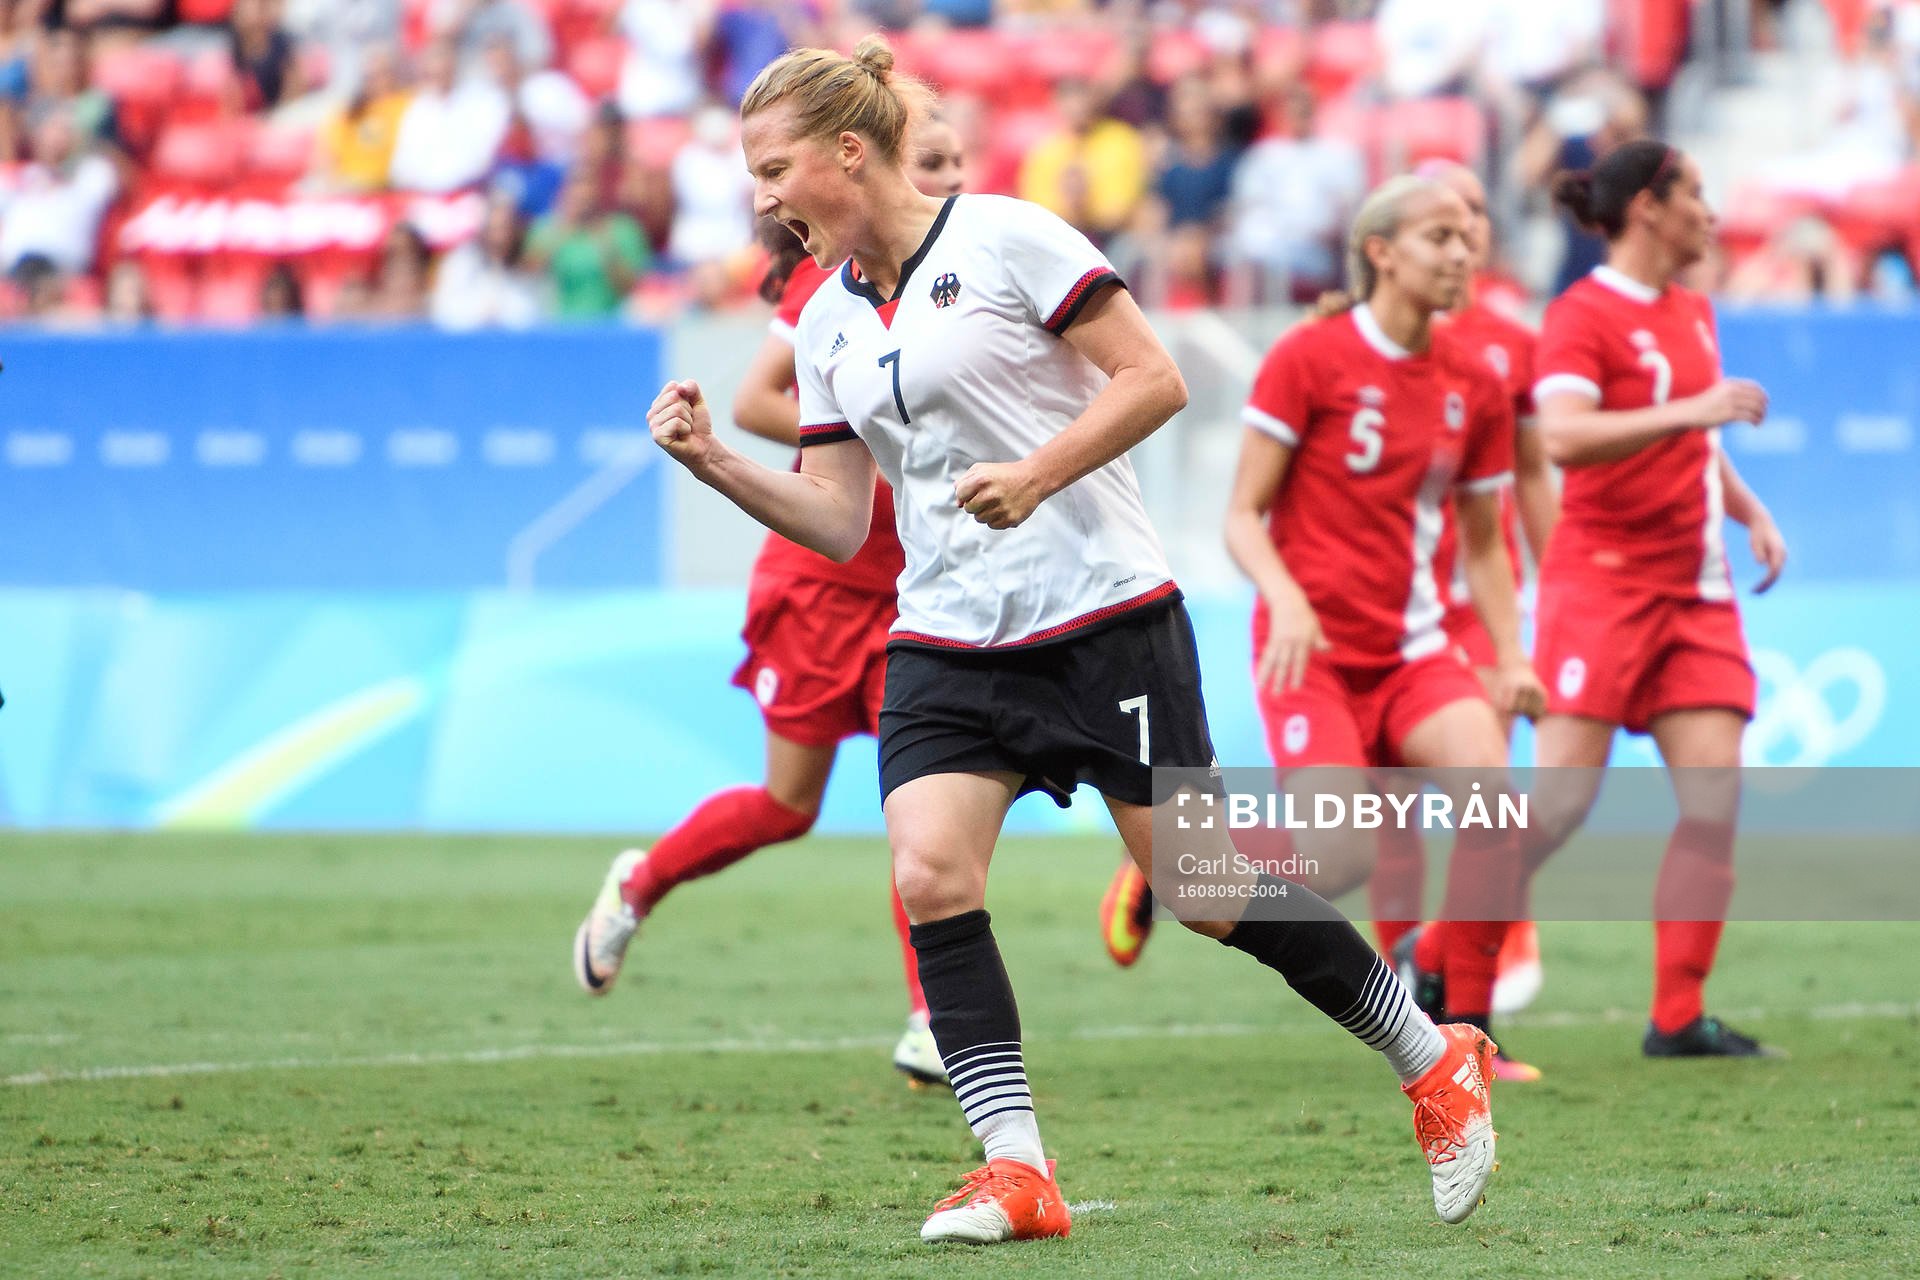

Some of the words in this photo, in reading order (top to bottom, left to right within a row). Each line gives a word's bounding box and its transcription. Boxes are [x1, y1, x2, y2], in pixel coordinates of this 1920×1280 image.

[878, 348, 911, 425] 7
[1345, 407, 1385, 473] 5
[1118, 694, 1150, 766] 7
[1465, 1053, 1489, 1105] adidas
